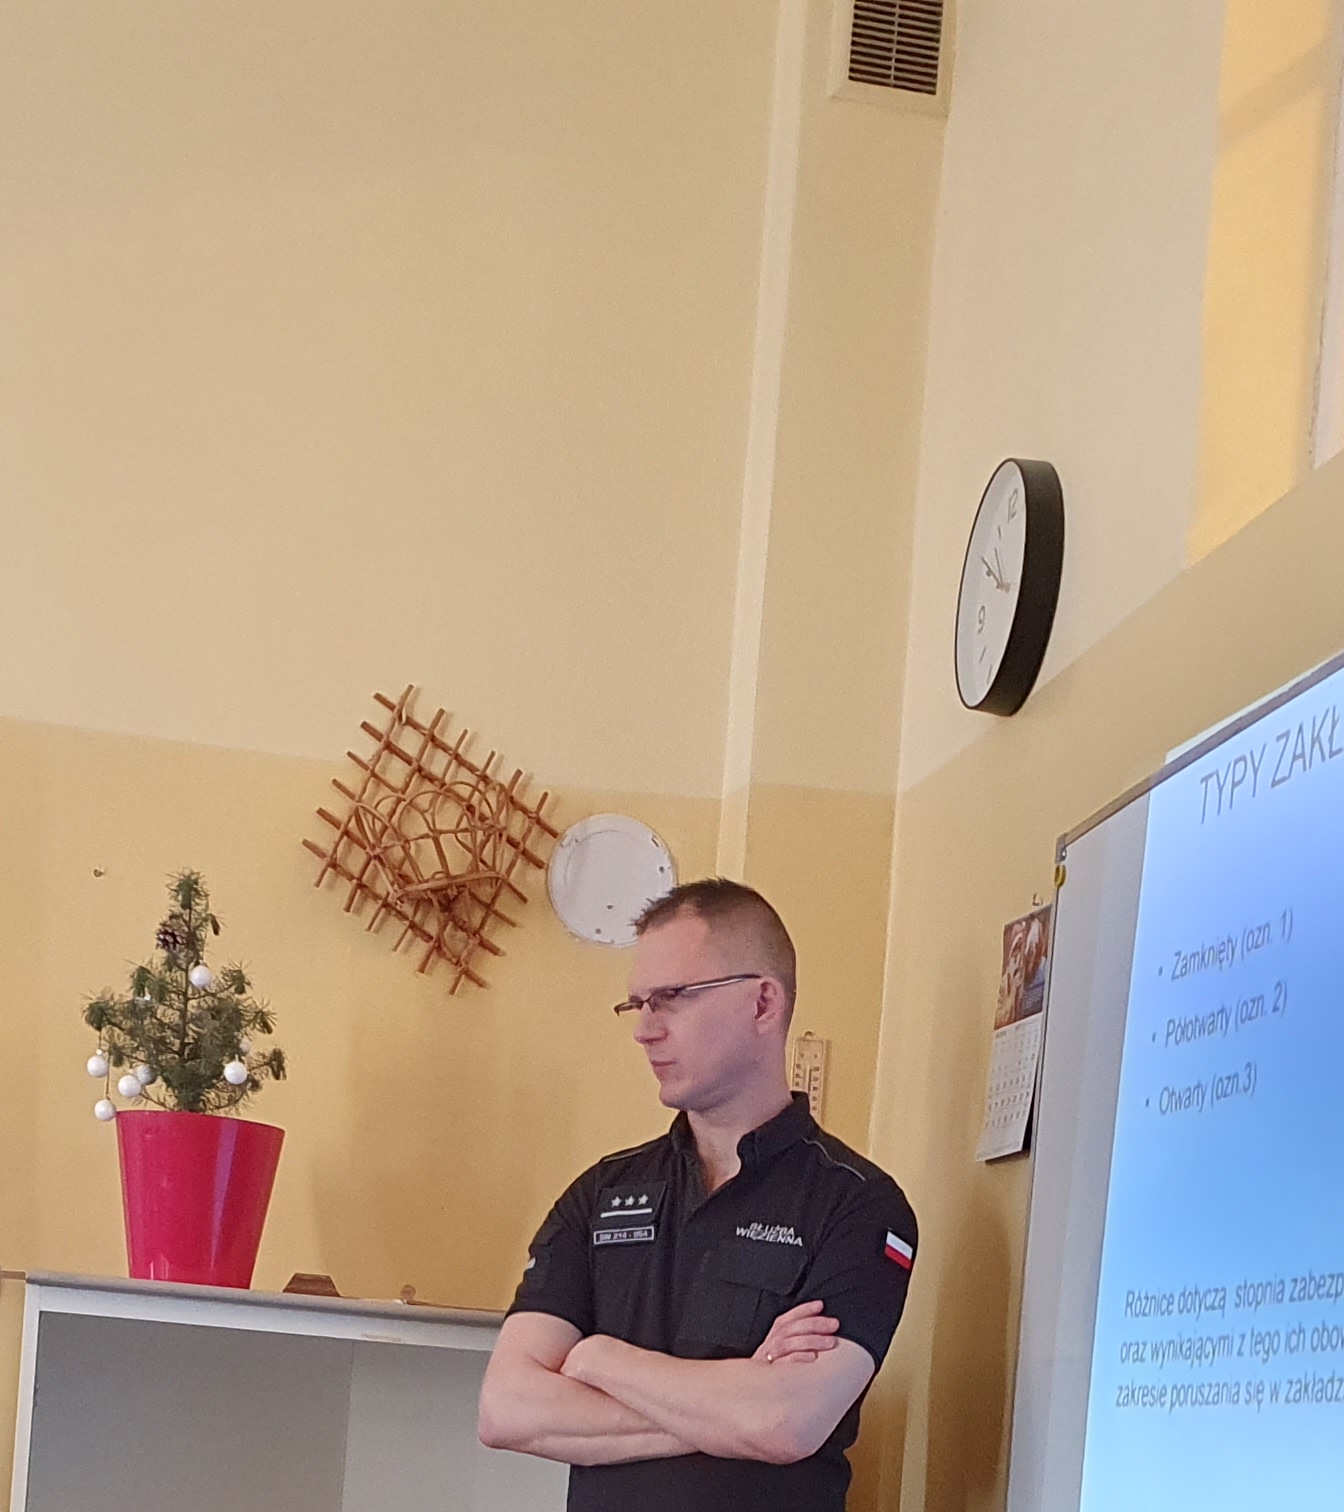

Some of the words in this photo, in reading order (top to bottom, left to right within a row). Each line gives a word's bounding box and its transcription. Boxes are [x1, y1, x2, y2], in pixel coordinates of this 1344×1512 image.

[1200, 742, 1267, 825] TYPY
[1171, 934, 1238, 981] Zamknięty
[1241, 920, 1273, 961] (ozn.
[1280, 906, 1294, 943] 1)
[1165, 1001, 1232, 1048] Półotwarty
[1234, 995, 1267, 1033] (ozn.
[1271, 978, 1288, 1017] 2)
[1158, 1078, 1209, 1116] Otwarty
[1124, 1287, 1175, 1318] Różnice
[1178, 1284, 1227, 1322] dotyczą
[1234, 1275, 1285, 1313] stopnia
[1120, 1339, 1147, 1365] oraz
[1150, 1328, 1235, 1370] wynikającymi
[1236, 1332, 1246, 1358] z
[1250, 1326, 1282, 1365] tego
[1284, 1319, 1306, 1355] ich
[1116, 1378, 1168, 1408] zakresie
[1168, 1374, 1241, 1415] poruszania
[1244, 1377, 1265, 1414] się
[1269, 1379, 1282, 1404] w
